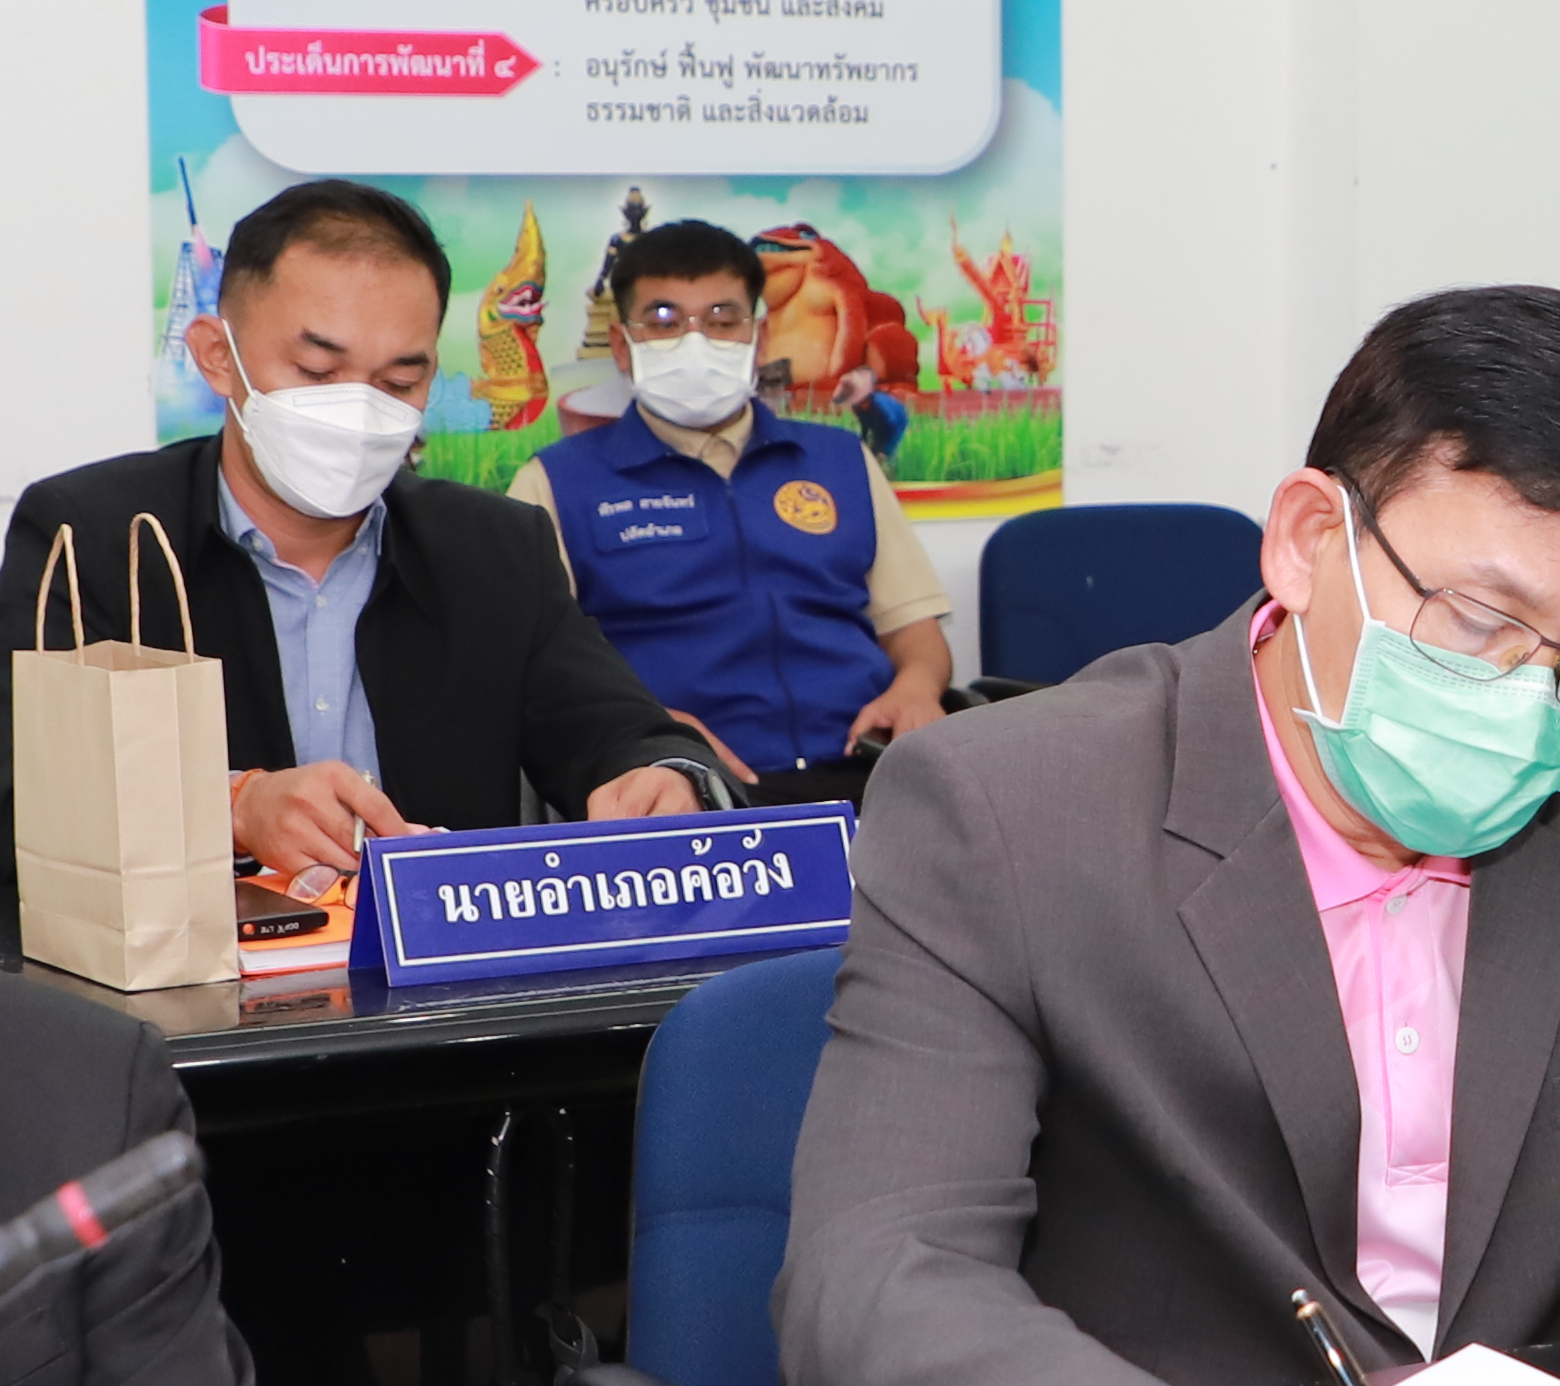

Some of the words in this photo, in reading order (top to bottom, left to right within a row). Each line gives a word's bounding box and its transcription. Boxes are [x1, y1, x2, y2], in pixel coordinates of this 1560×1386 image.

[245, 39, 485, 78] ประเด็นการพัฒนาที่
[586, 50, 668, 86] อนุรักษ์
[678, 41, 734, 88] ฟื้นฟู
[745, 54, 918, 82] พัฒนาทรัพยากร
[587, 95, 691, 123] ธรรมชาติ
[703, 90, 869, 124] และสิ่งแวดล้อม
[439, 829, 795, 924] นายอำเภอค้อวัง
